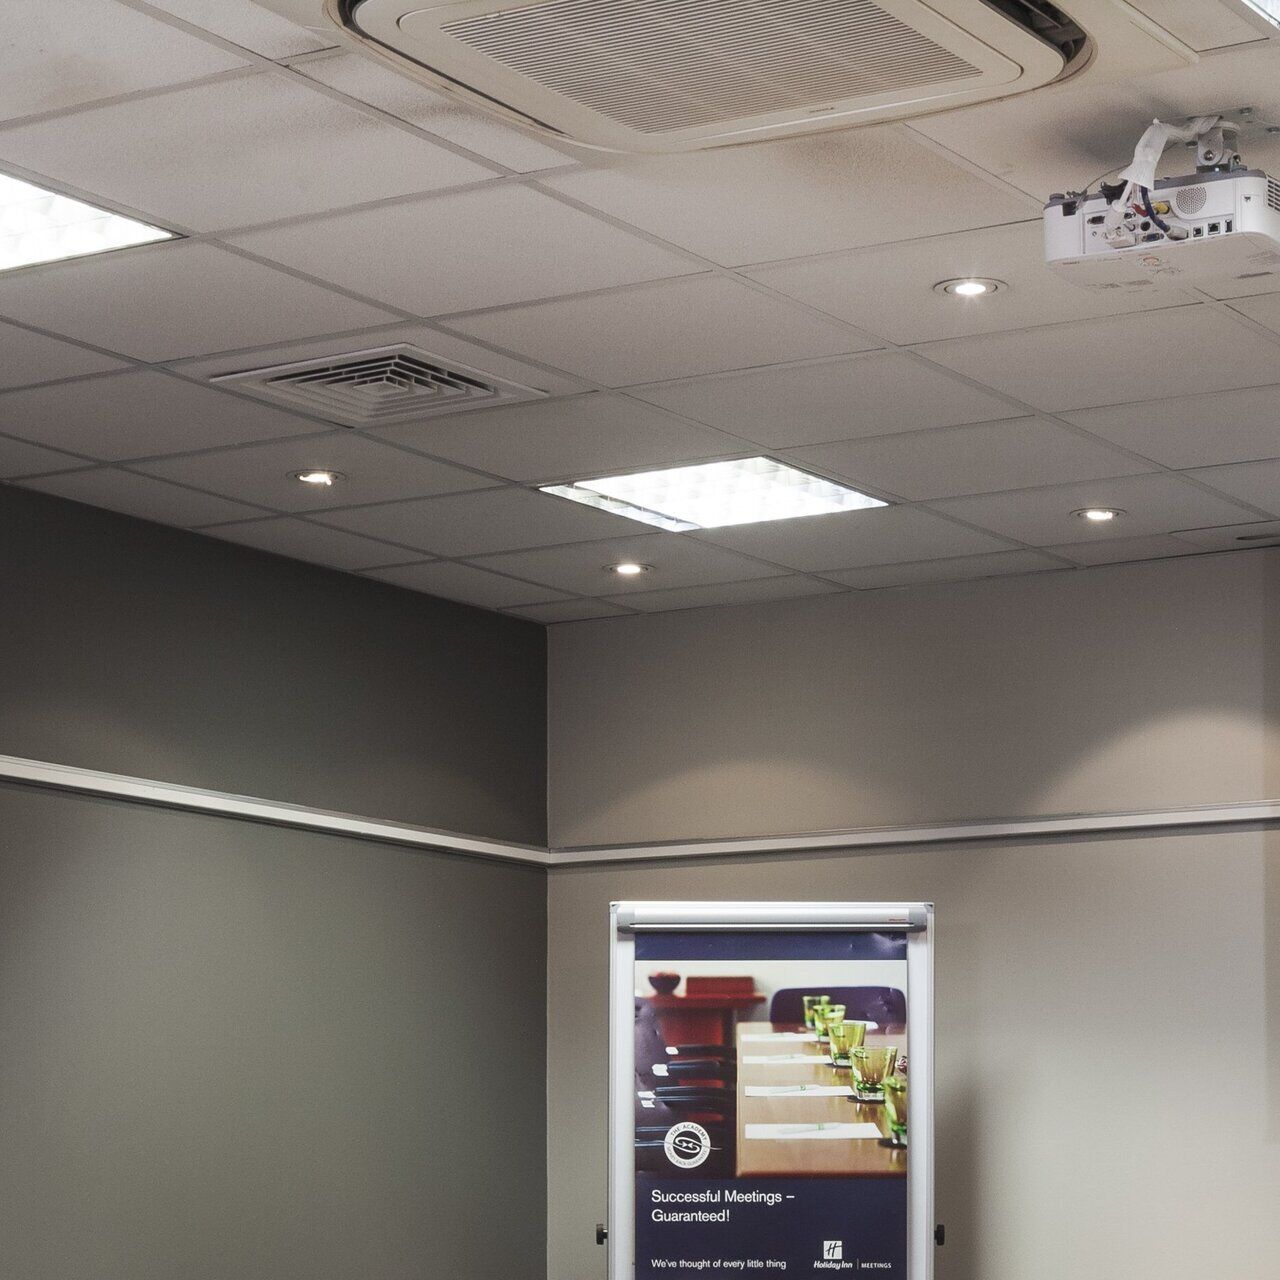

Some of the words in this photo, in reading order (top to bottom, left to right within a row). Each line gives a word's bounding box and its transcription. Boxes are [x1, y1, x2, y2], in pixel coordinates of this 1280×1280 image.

[670, 1128, 680, 1137] THE
[682, 1124, 708, 1141] ACADEMY
[651, 1190, 721, 1203] Successful
[724, 1190, 783, 1206] Meetings
[651, 1209, 730, 1222] Guaranteed!
[651, 1259, 677, 1269] We've
[679, 1259, 711, 1270] thought
[713, 1259, 721, 1268] of
[723, 1260, 745, 1270] every
[746, 1259, 764, 1268] little
[766, 1259, 787, 1270] thing
[813, 1260, 841, 1270] Holiday
[841, 1260, 853, 1269] Inn
